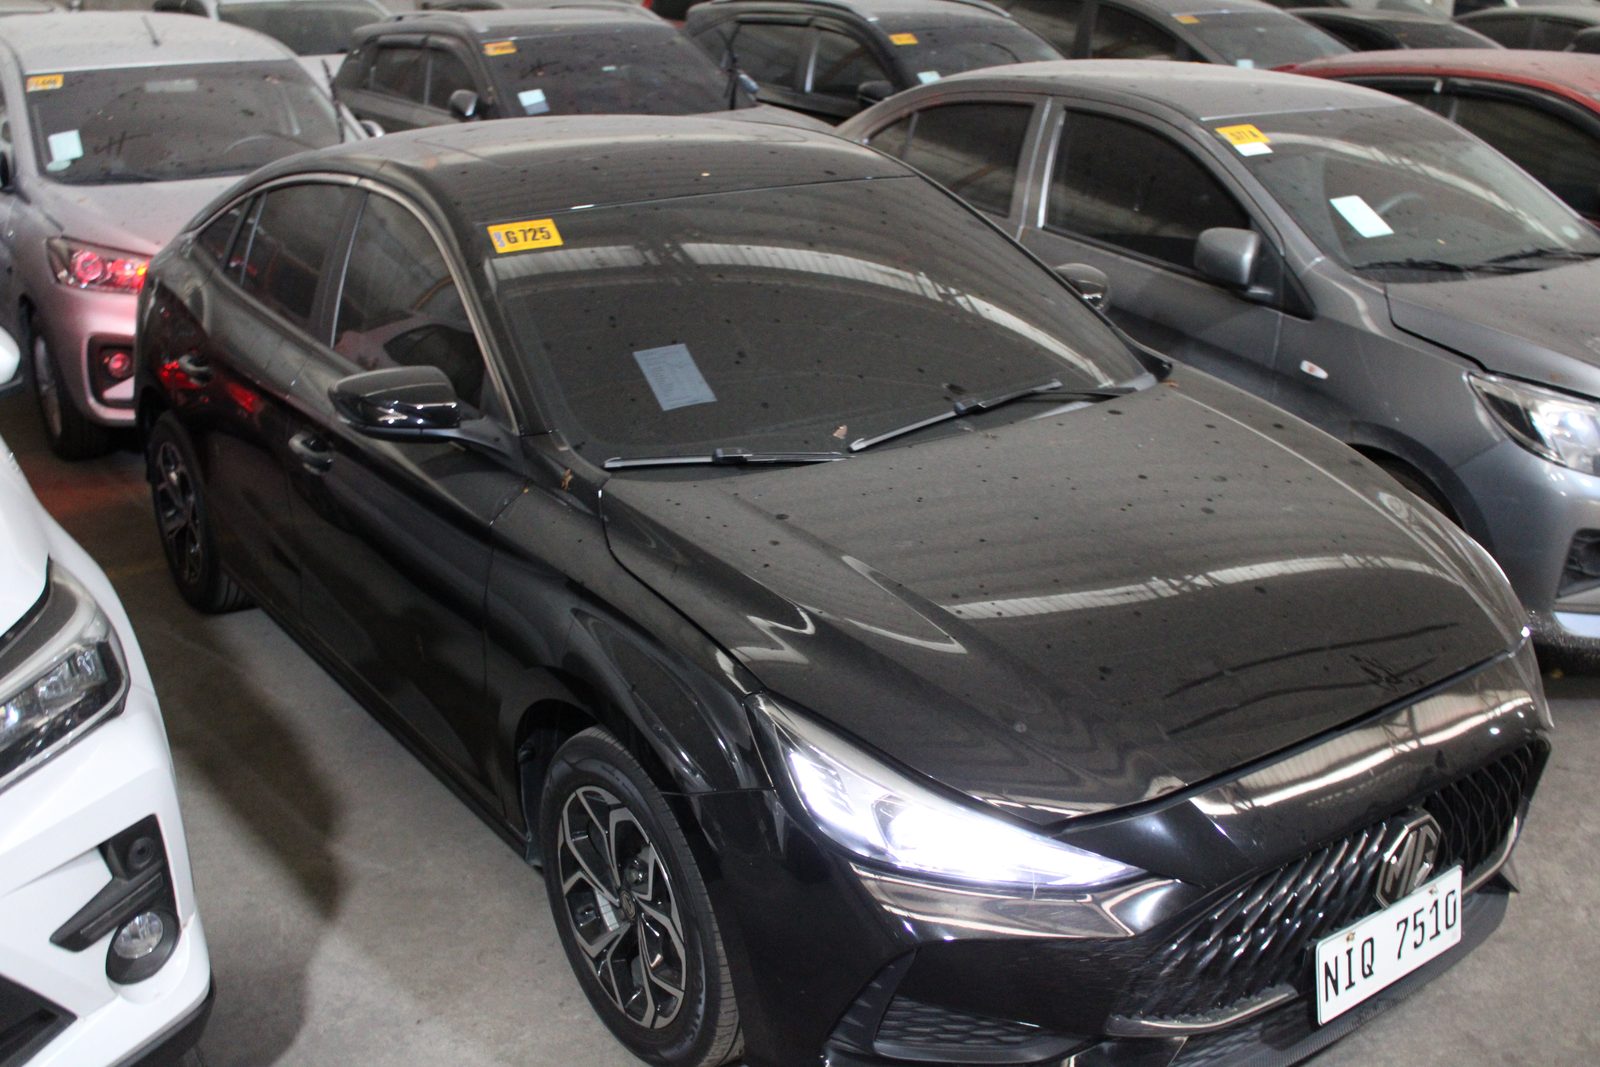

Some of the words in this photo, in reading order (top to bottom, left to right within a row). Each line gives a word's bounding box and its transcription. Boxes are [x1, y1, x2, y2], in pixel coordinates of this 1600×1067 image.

[505, 230, 518, 244] G
[519, 226, 551, 242] 725
[1384, 824, 1438, 900] MG
[1324, 937, 1375, 1002] NIQ
[1396, 890, 1456, 960] 7510
